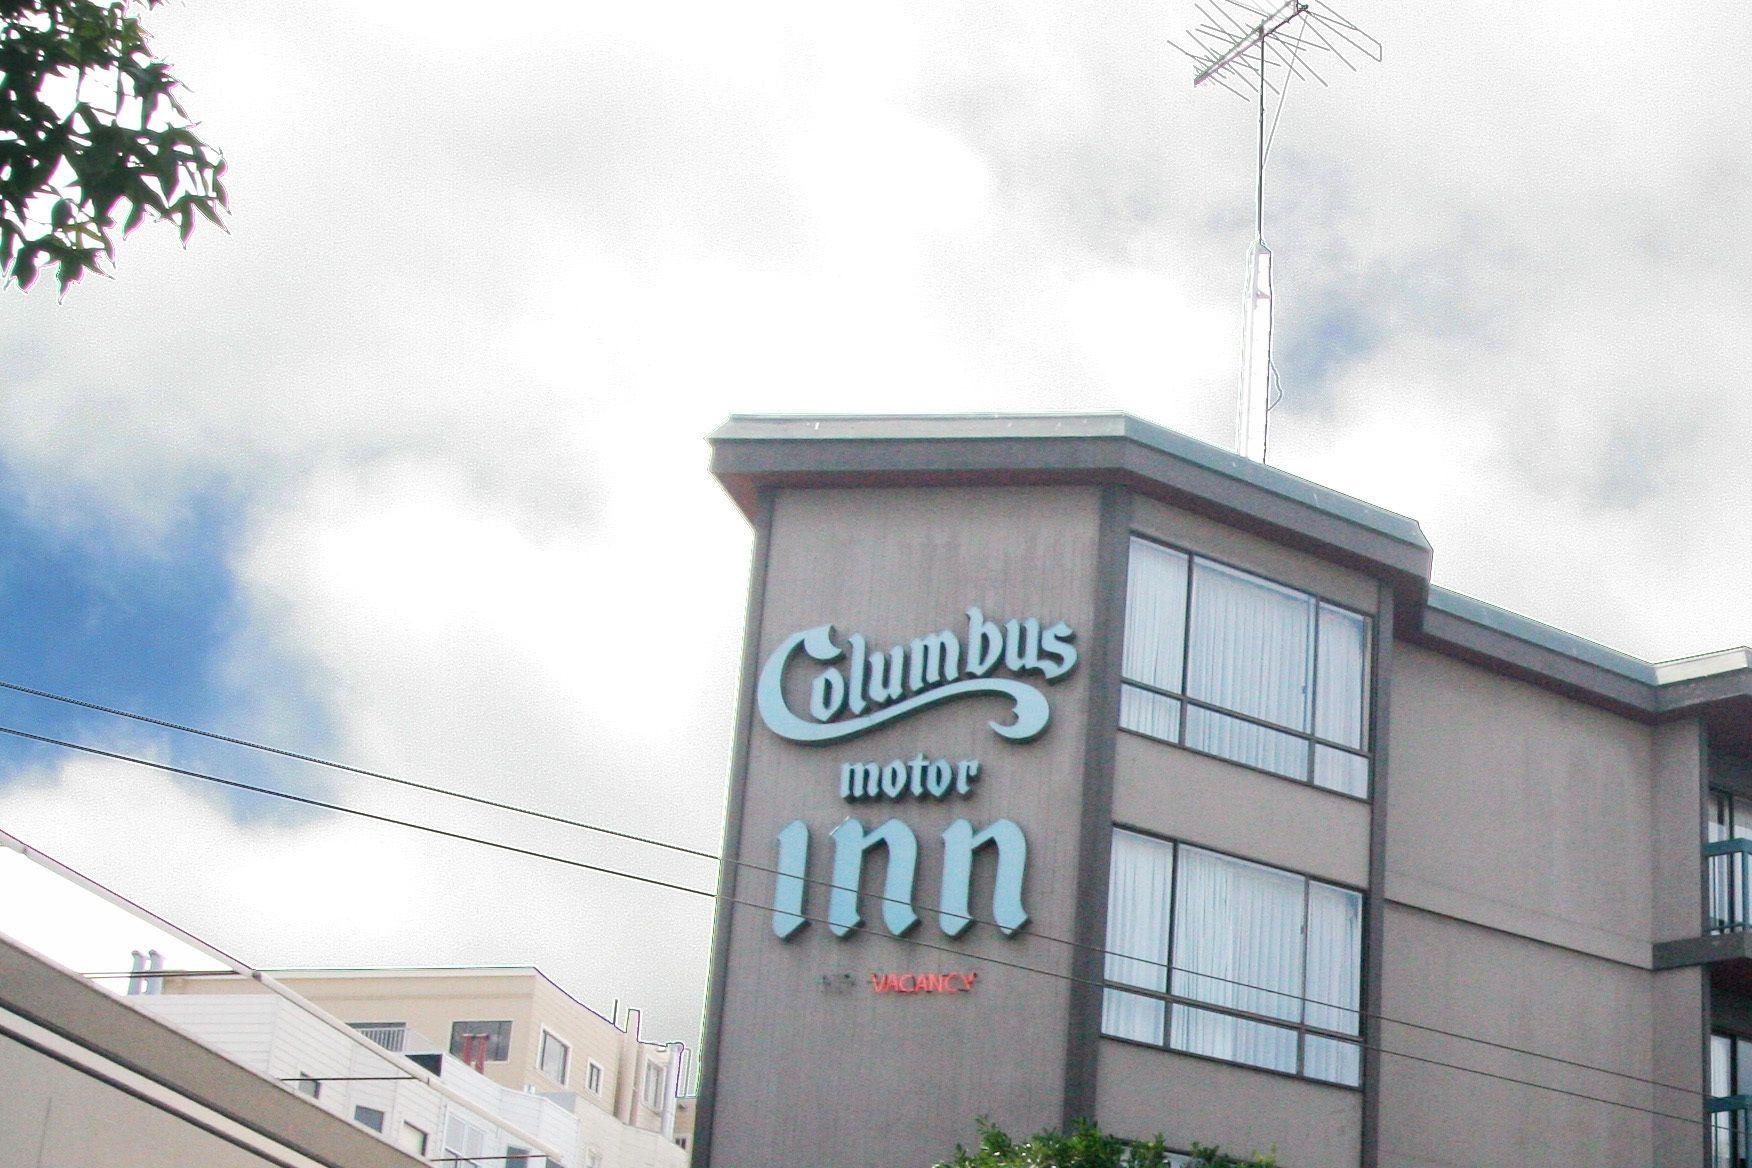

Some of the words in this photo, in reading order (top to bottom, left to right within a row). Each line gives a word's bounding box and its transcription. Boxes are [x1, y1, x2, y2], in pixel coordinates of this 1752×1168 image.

[757, 606, 1079, 744] Columbus
[839, 752, 980, 799] motor
[871, 972, 978, 994] VACANCY
